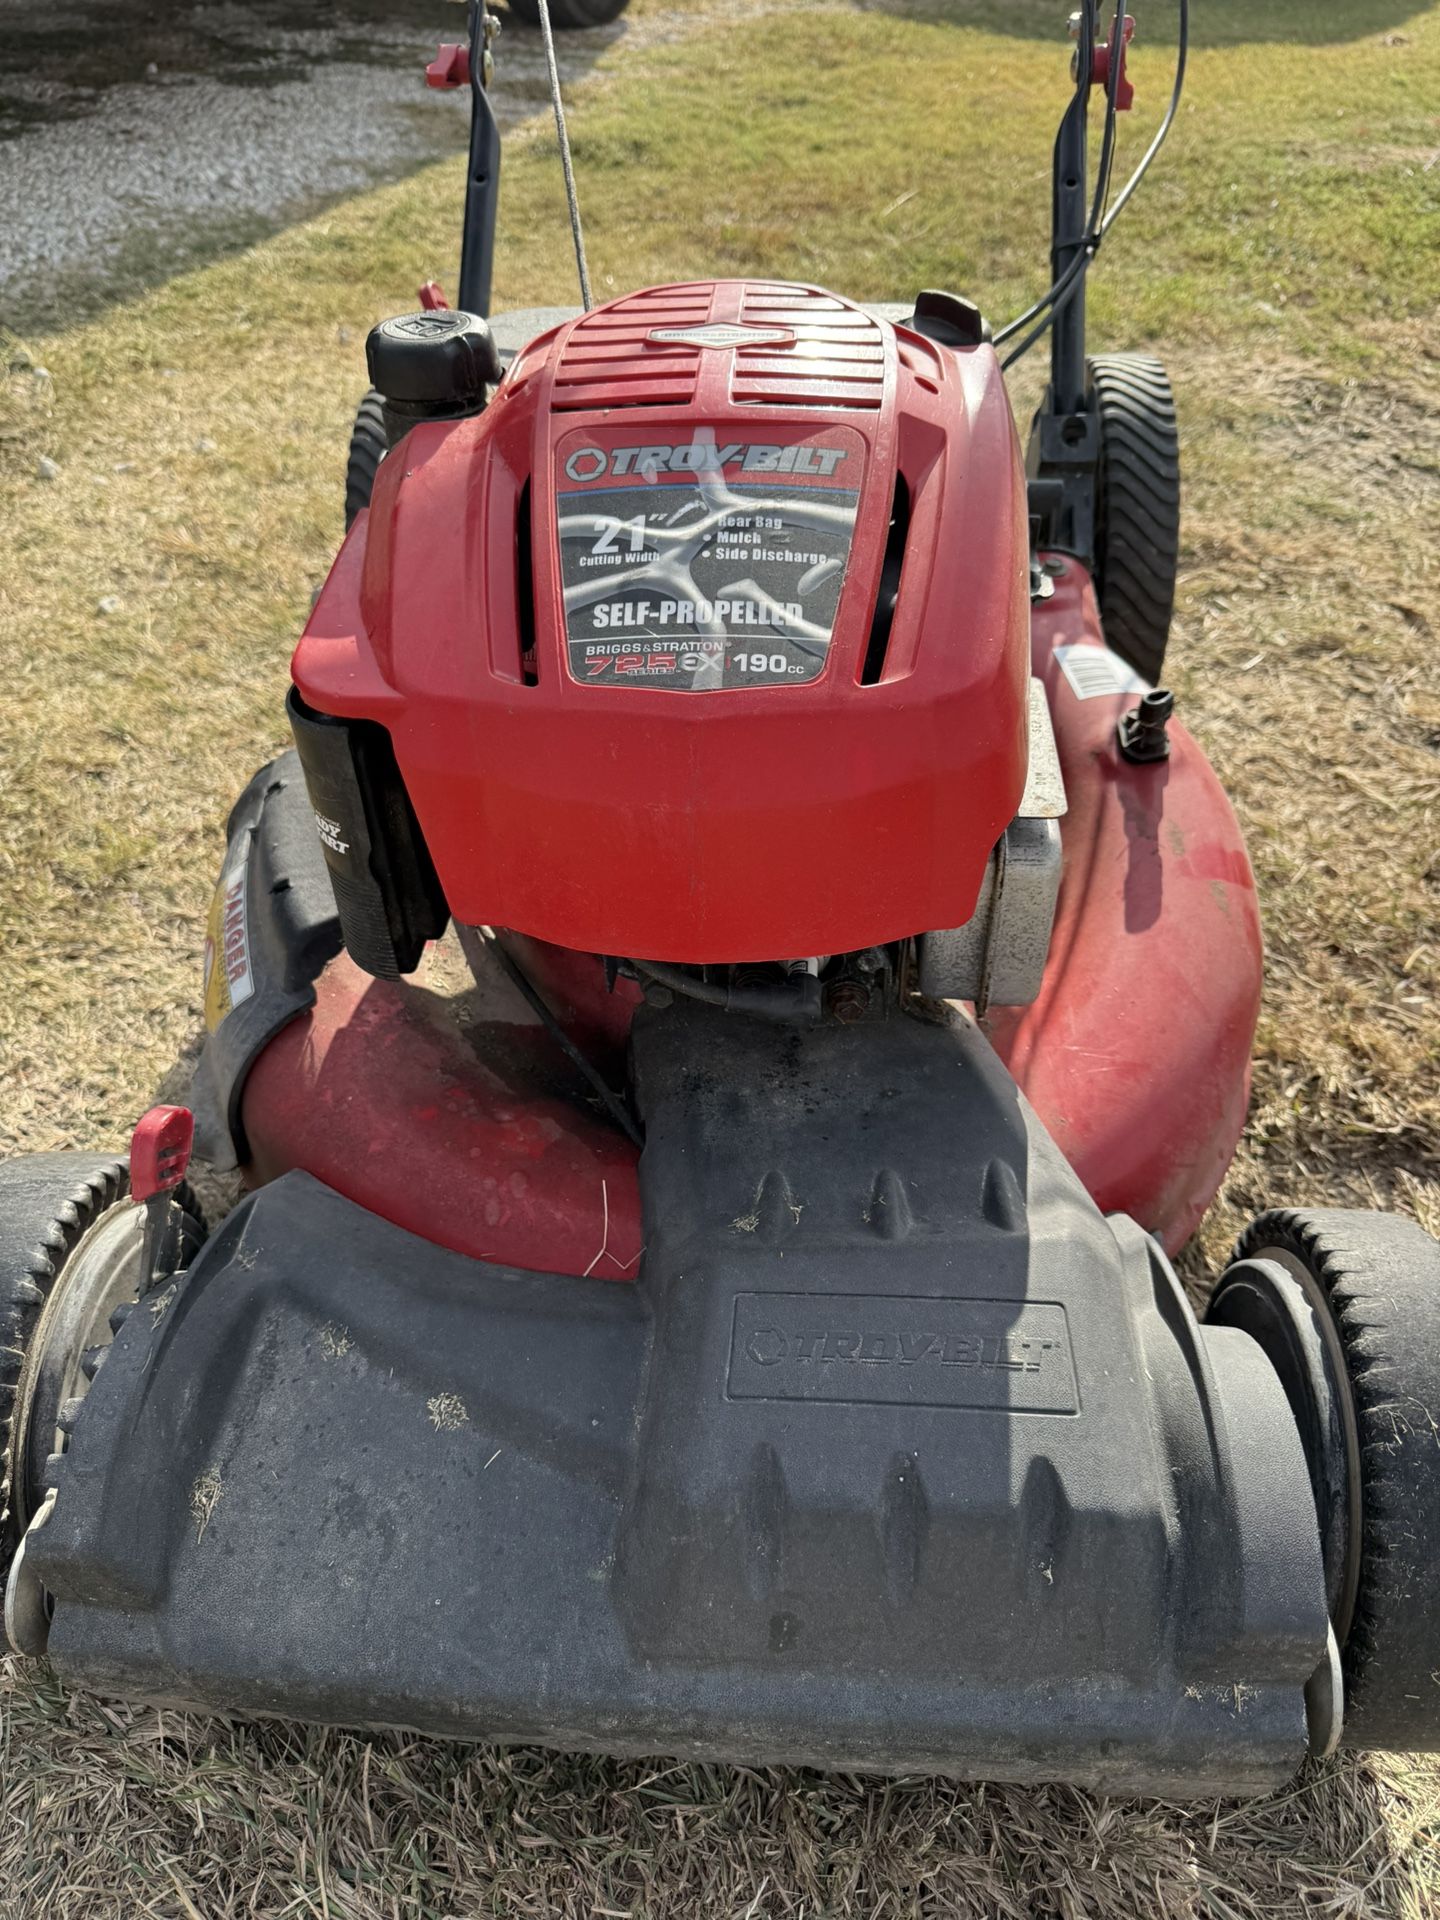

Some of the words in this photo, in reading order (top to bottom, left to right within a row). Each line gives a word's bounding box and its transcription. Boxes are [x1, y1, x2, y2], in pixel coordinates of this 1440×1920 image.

[611, 444, 847, 476] TROY-BILT
[718, 516, 750, 528] Rear
[755, 516, 782, 529] Bag
[717, 532, 761, 544] Mulch
[580, 554, 621, 567] Cutting
[625, 551, 660, 563] Width
[715, 548, 748, 560] Side
[752, 548, 827, 565] Discharge
[593, 600, 803, 628] SELF-PROPELLED
[225, 880, 248, 983] DANGER
[796, 1330, 1058, 1372] TROY-BILT
